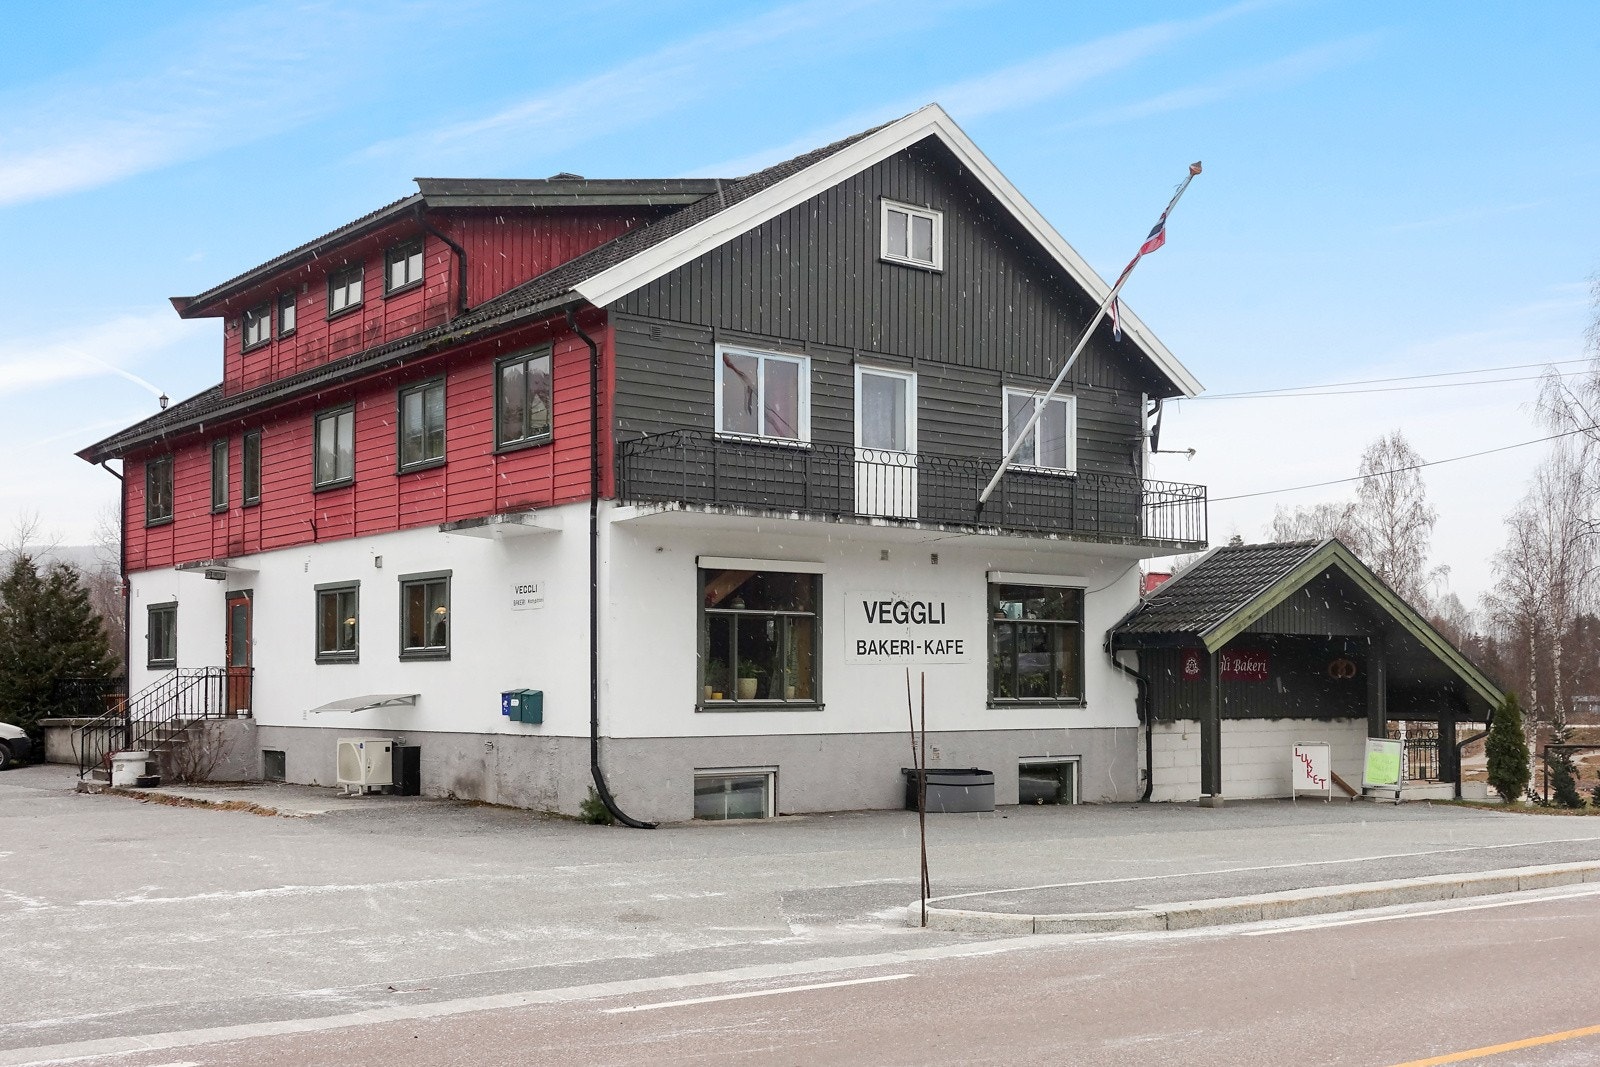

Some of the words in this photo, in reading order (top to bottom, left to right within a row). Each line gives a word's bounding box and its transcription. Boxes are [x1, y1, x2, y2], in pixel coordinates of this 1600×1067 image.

[863, 600, 946, 624] VEGGLI
[1233, 657, 1267, 674] Bakeri
[1295, 747, 1327, 789] LUKKET
